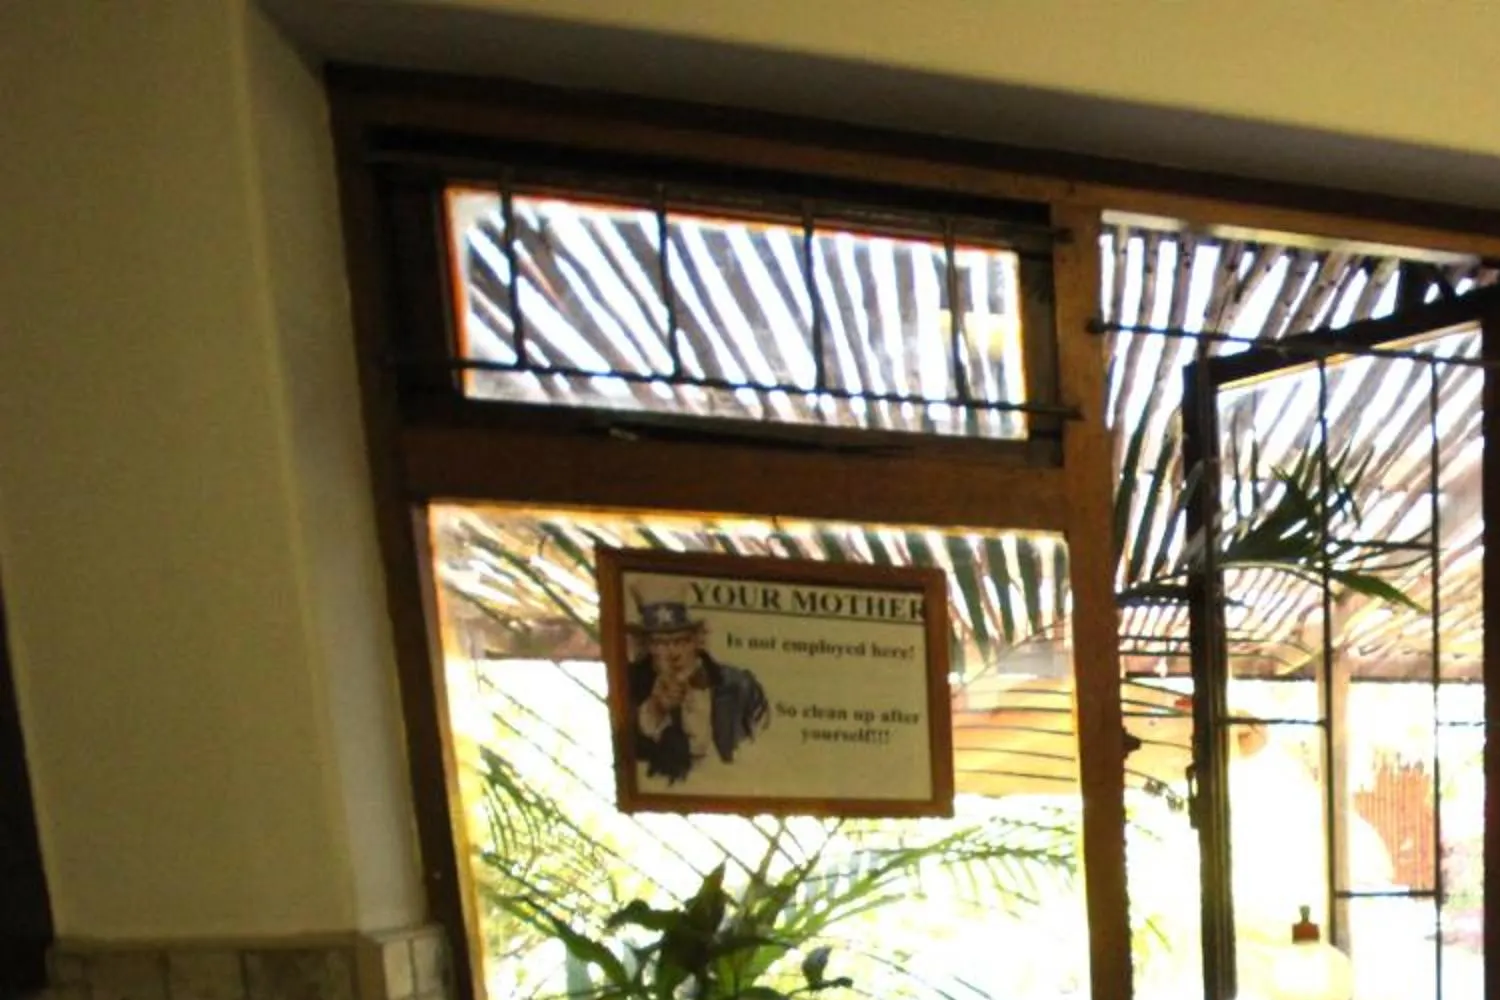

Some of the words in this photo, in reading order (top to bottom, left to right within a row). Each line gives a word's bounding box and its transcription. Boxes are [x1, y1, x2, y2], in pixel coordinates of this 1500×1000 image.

[690, 581, 782, 611] YOUR
[791, 588, 924, 621] MOTHER
[726, 632, 743, 648] Is
[747, 636, 776, 650] not
[781, 639, 866, 658] employed
[871, 643, 915, 660] here!
[775, 701, 797, 719] So
[802, 704, 847, 720] clean
[853, 708, 874, 725] up
[880, 708, 919, 724] after
